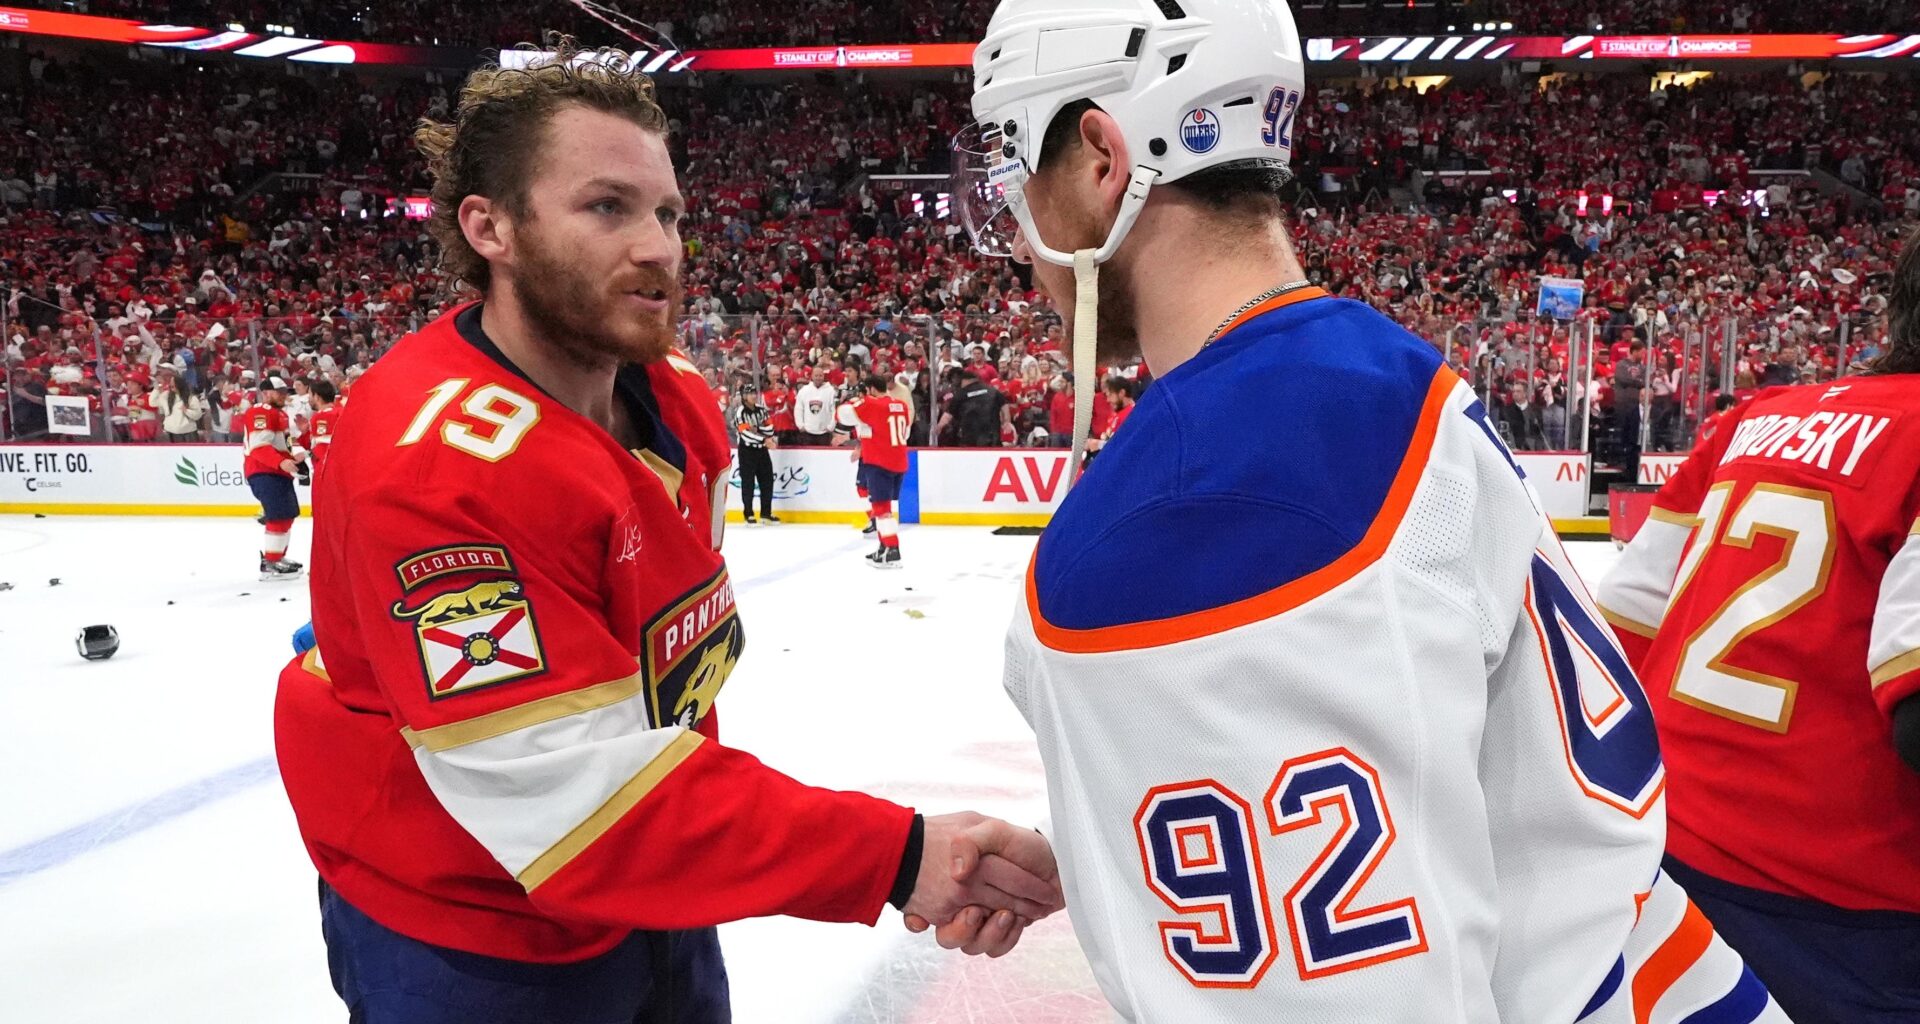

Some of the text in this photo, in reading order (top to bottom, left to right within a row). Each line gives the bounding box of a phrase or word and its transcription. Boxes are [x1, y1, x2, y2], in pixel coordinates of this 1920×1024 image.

[781, 52, 816, 62] STANLEY
[817, 52, 834, 61] CUP
[847, 51, 900, 61] CHAMPIONS
[1608, 42, 1647, 51] STANLEY
[1648, 42, 1667, 51] CUP
[1680, 41, 1737, 51] CHAMPIONS
[1184, 123, 1216, 138] OILERS
[1261, 86, 1299, 150] 92
[395, 378, 542, 463] 19
[887, 415, 907, 446] 10
[0, 453, 92, 473] IVE. FIT. GO.
[201, 464, 250, 487] idea
[410, 552, 495, 578] FLORIDA
[665, 574, 735, 661] PANTHE
[1658, 480, 1837, 735] 72
[1133, 747, 1429, 989] 92
